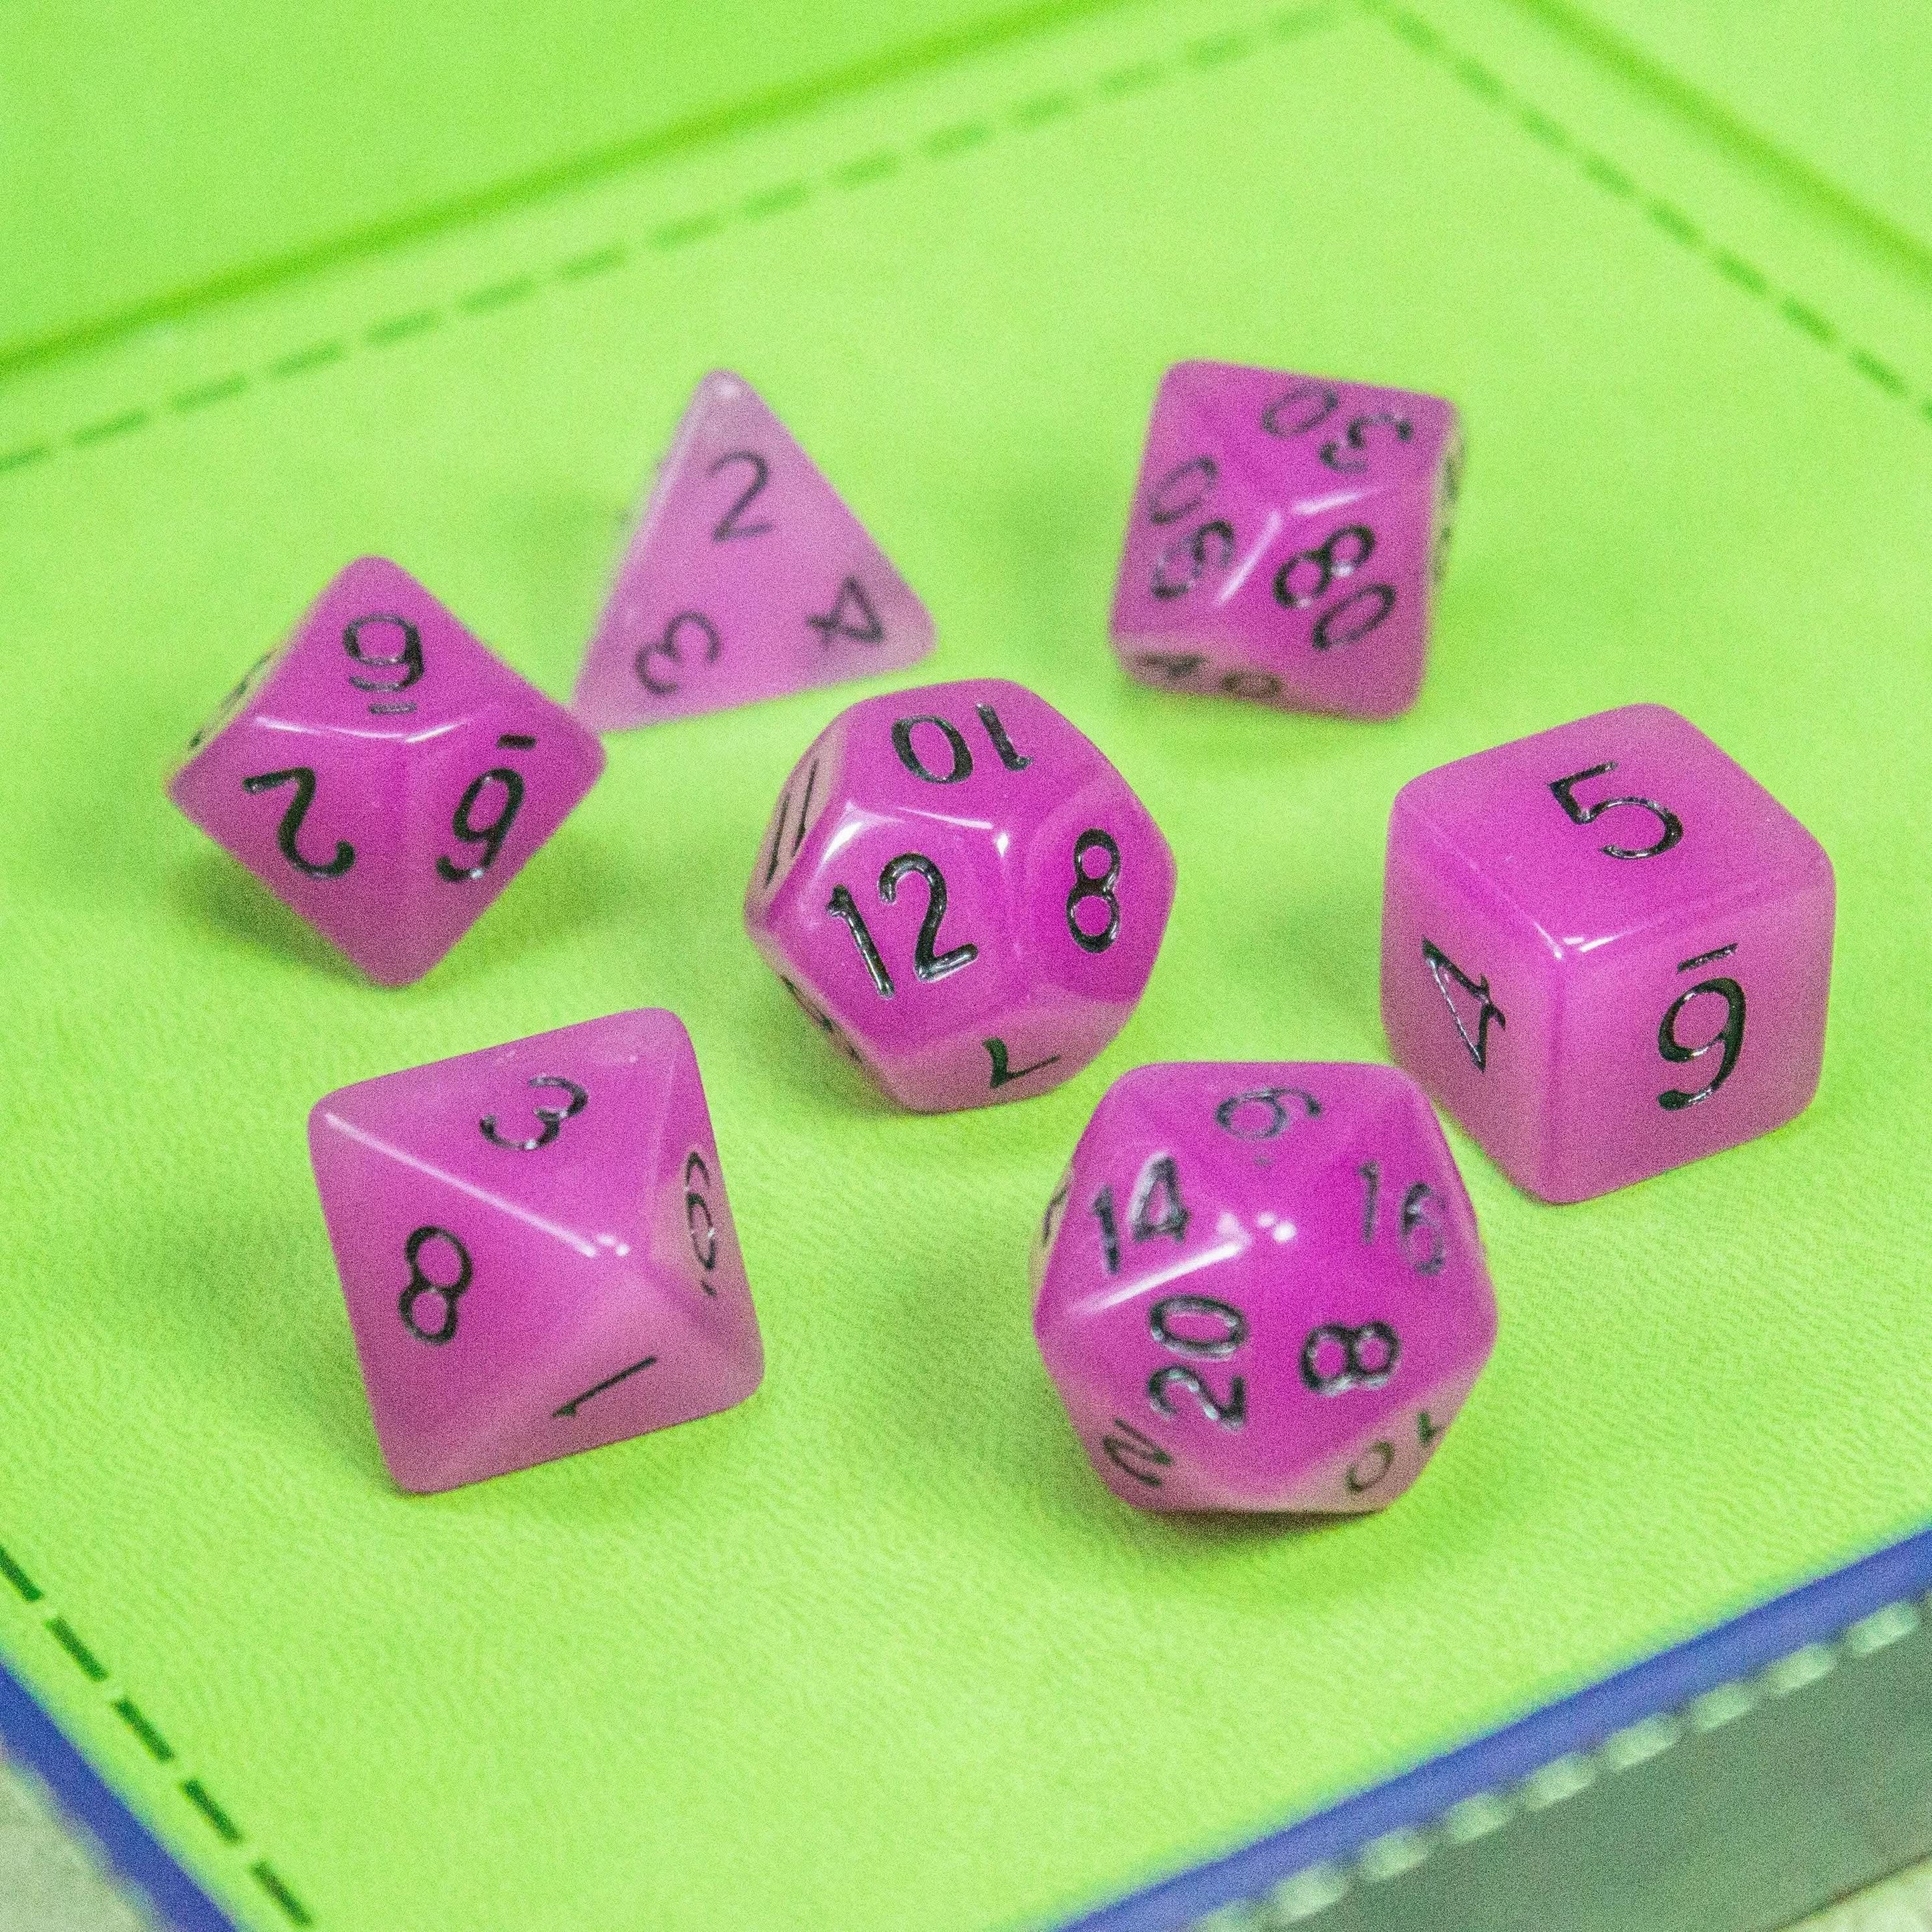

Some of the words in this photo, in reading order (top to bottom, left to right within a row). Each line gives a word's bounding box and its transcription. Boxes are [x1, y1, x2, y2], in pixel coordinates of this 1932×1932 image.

[1261, 383, 1414, 474] 30
[709, 450, 773, 542] 2
[806, 576, 883, 647] 4
[1273, 523, 1396, 651] 80
[634, 611, 721, 695] 3
[891, 701, 1033, 784] 10
[243, 766, 355, 879] 2
[1549, 761, 1684, 860] 5
[826, 852, 978, 999] 12
[1066, 828, 1121, 953] 8
[1422, 937, 1506, 1073] 4
[479, 1075, 589, 1150] 3
[1093, 1149, 1190, 1275] 14
[1358, 1161, 1446, 1276] 16
[398, 1225, 472, 1346] 8
[552, 1355, 658, 1418] 1
[1146, 1294, 1249, 1432] 20
[1300, 1321, 1402, 1398] 8
